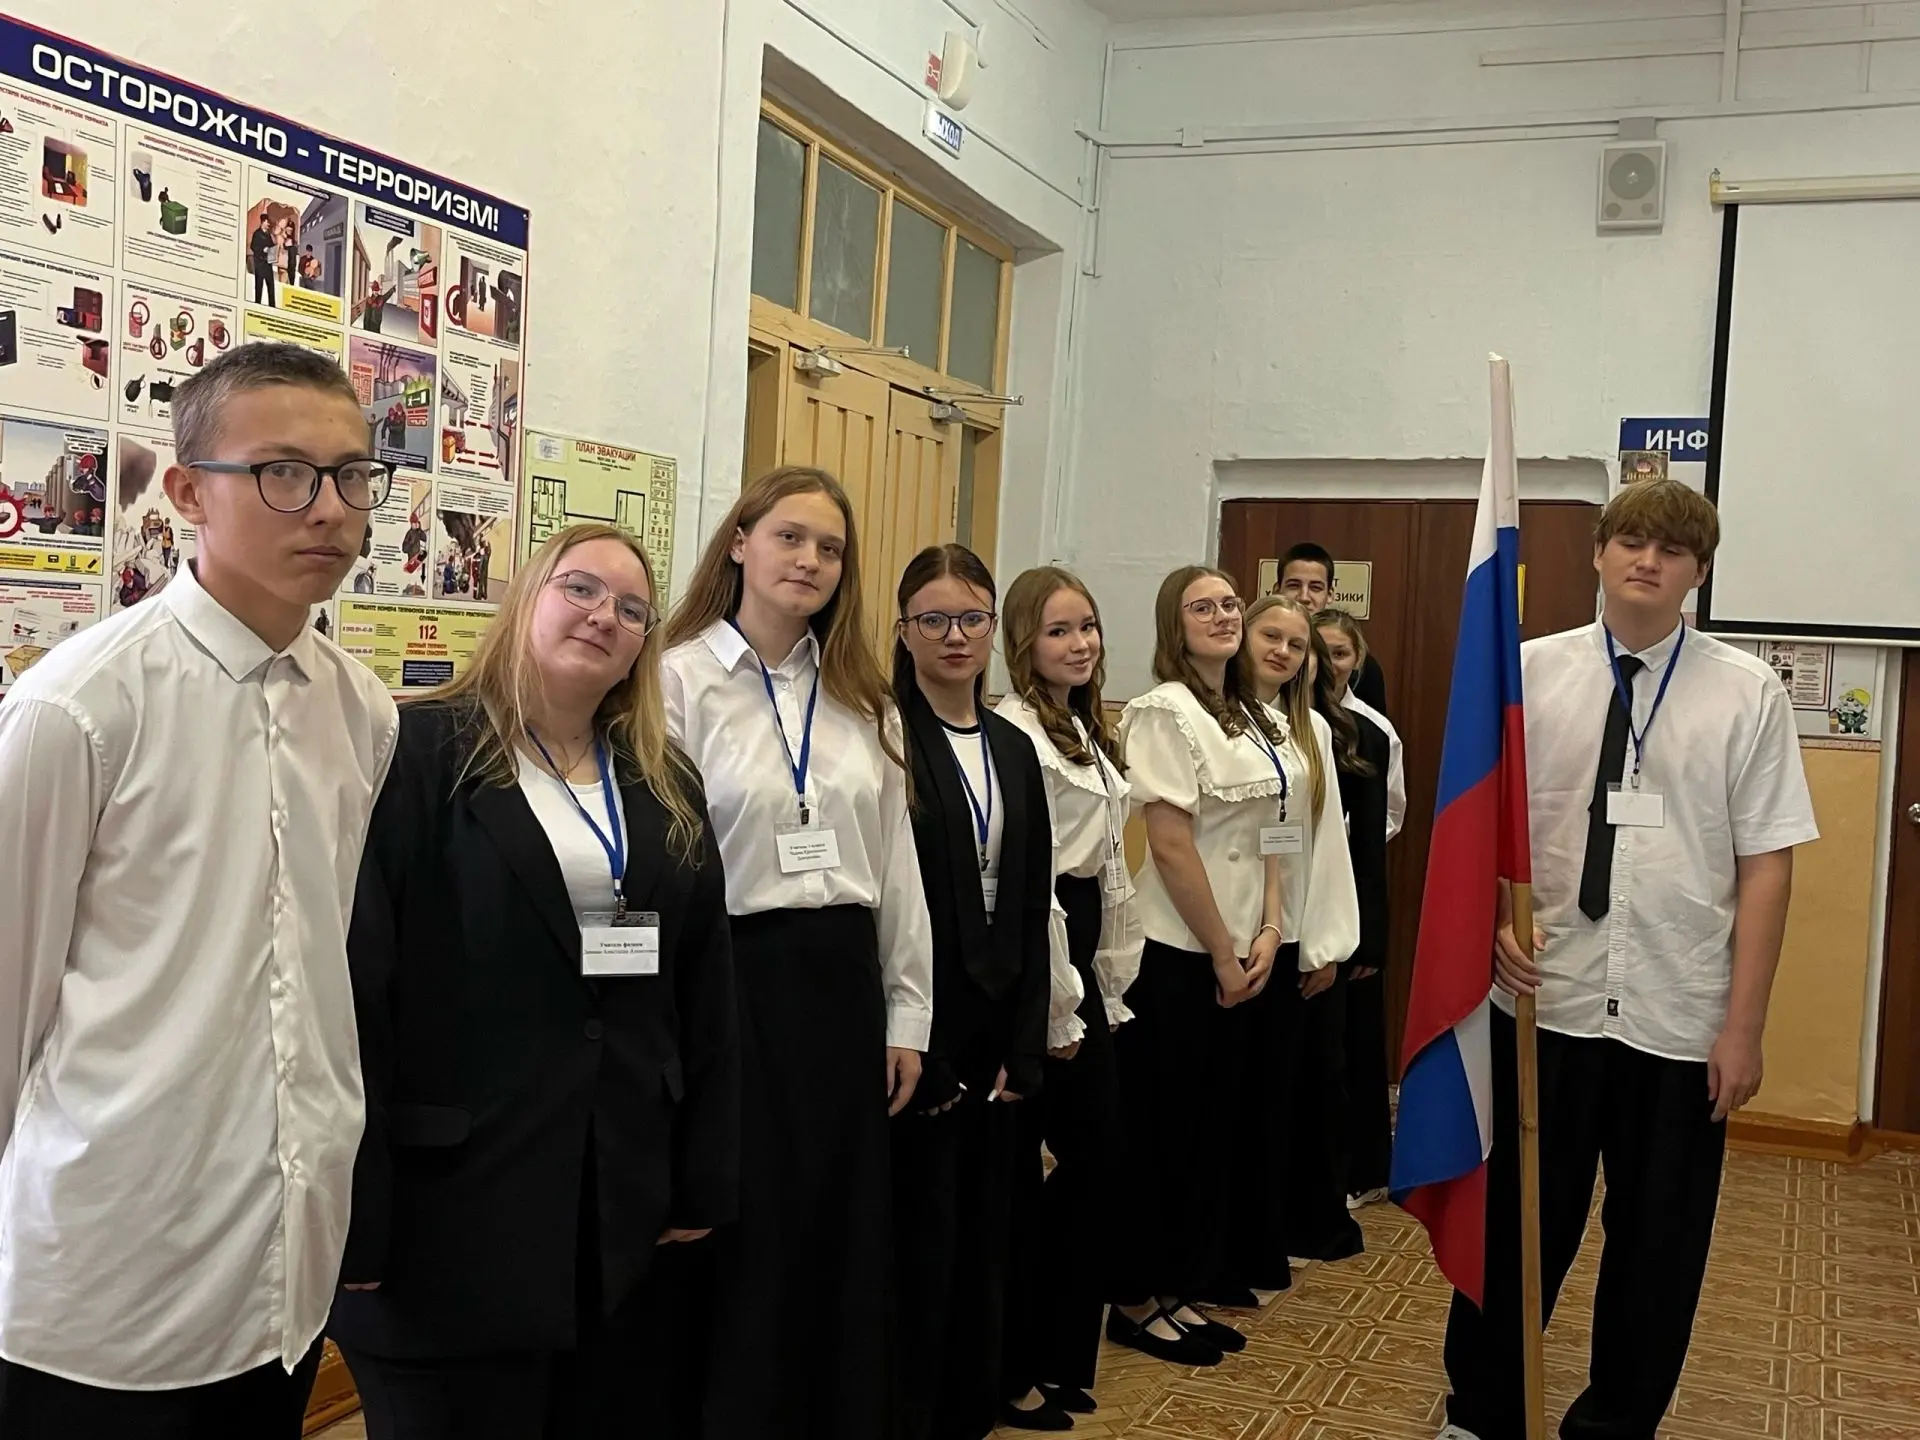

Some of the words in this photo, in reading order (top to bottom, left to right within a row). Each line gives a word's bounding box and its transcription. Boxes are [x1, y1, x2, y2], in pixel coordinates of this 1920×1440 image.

[32, 43, 287, 159] ОСТОРОЖНО
[319, 144, 500, 232] ТЕРРОРИЗМ!
[1645, 429, 1709, 450] ИНФ
[575, 442, 596, 454] ПЛАН
[596, 446, 637, 462] ЭВАКУАЦИИ
[1334, 592, 1364, 603] ЗИКИ
[419, 625, 437, 640] 112
